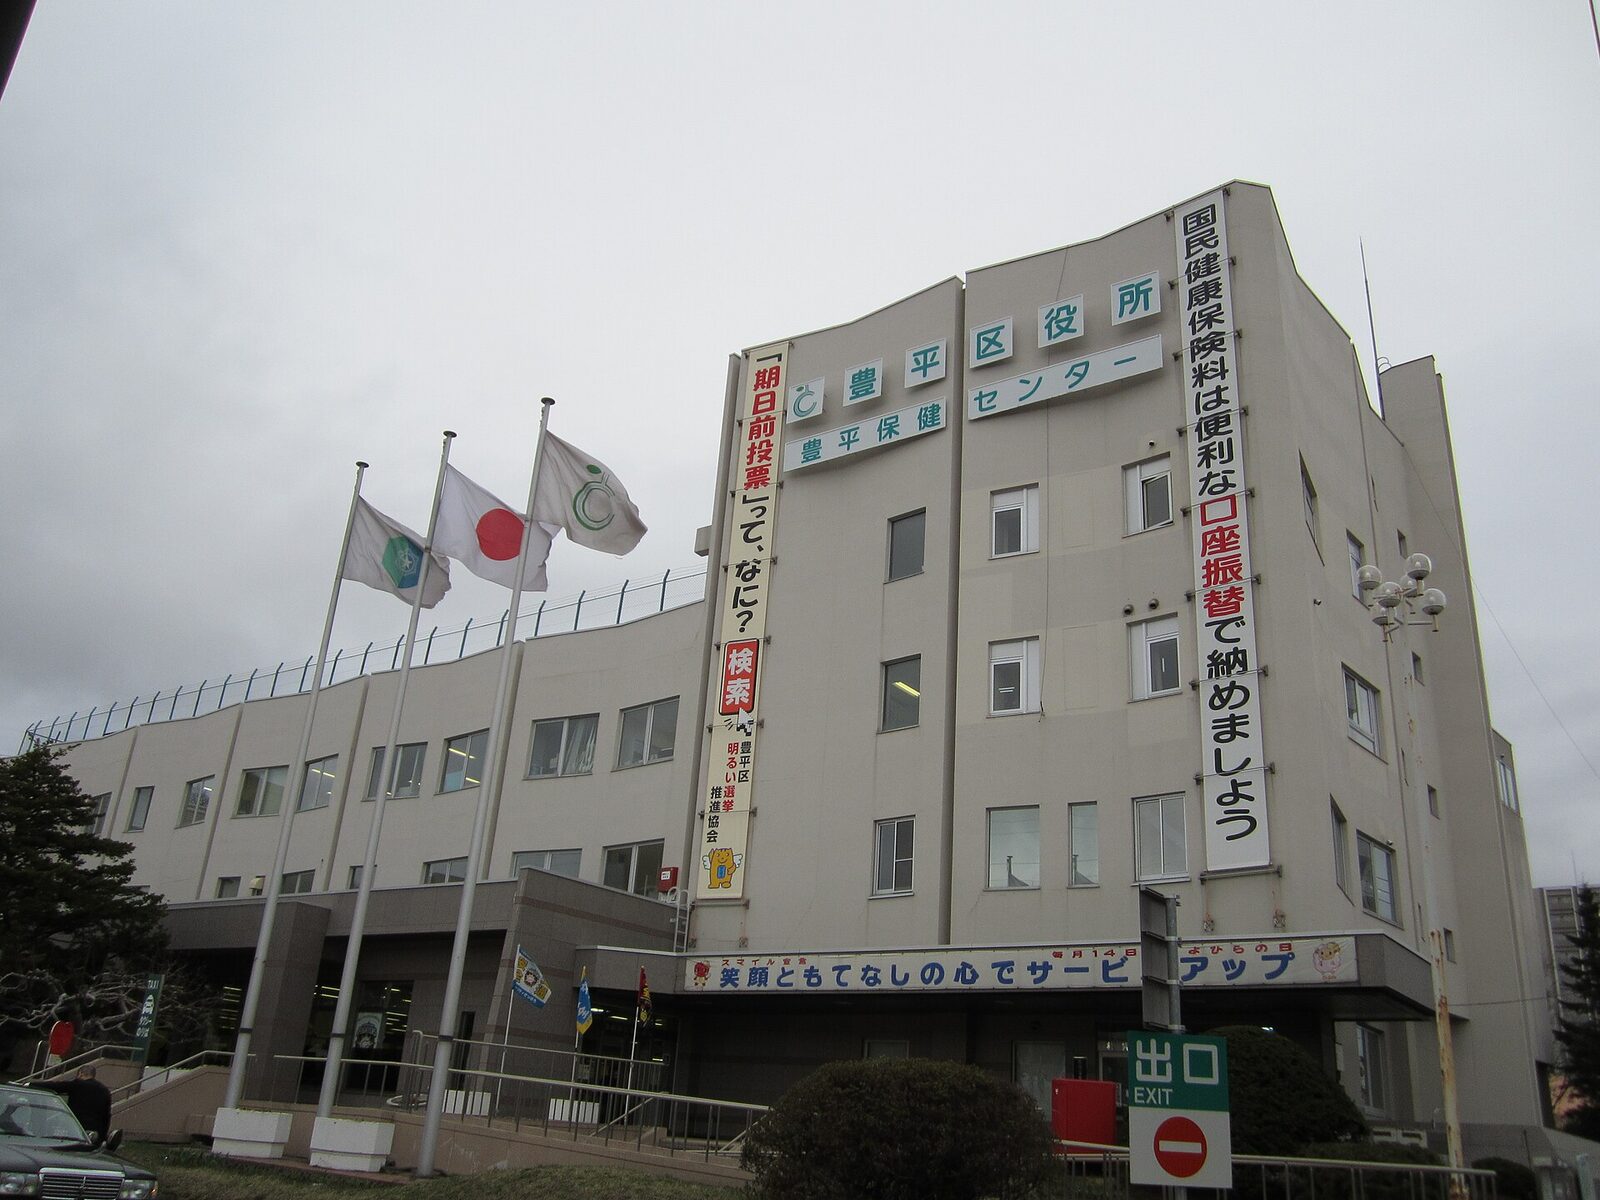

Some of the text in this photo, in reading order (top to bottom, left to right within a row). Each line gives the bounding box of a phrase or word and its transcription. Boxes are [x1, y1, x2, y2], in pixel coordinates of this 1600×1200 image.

[849, 277, 1154, 401] 豊平区役所
[800, 356, 1137, 464] 豊平保健センター
[1183, 203, 1258, 841] 国民健康保険料は便利な口座振替で納めましょう
[725, 647, 754, 706] 検索
[722, 742, 740, 812] 明るい選挙
[738, 740, 752, 783] 豊平区
[706, 785, 722, 843] 推進協会
[720, 952, 1295, 989] 笑顔ともてなしの心でサービアップ
[1135, 1037, 1220, 1086] 出口
[1134, 1086, 1173, 1105] EXIT
